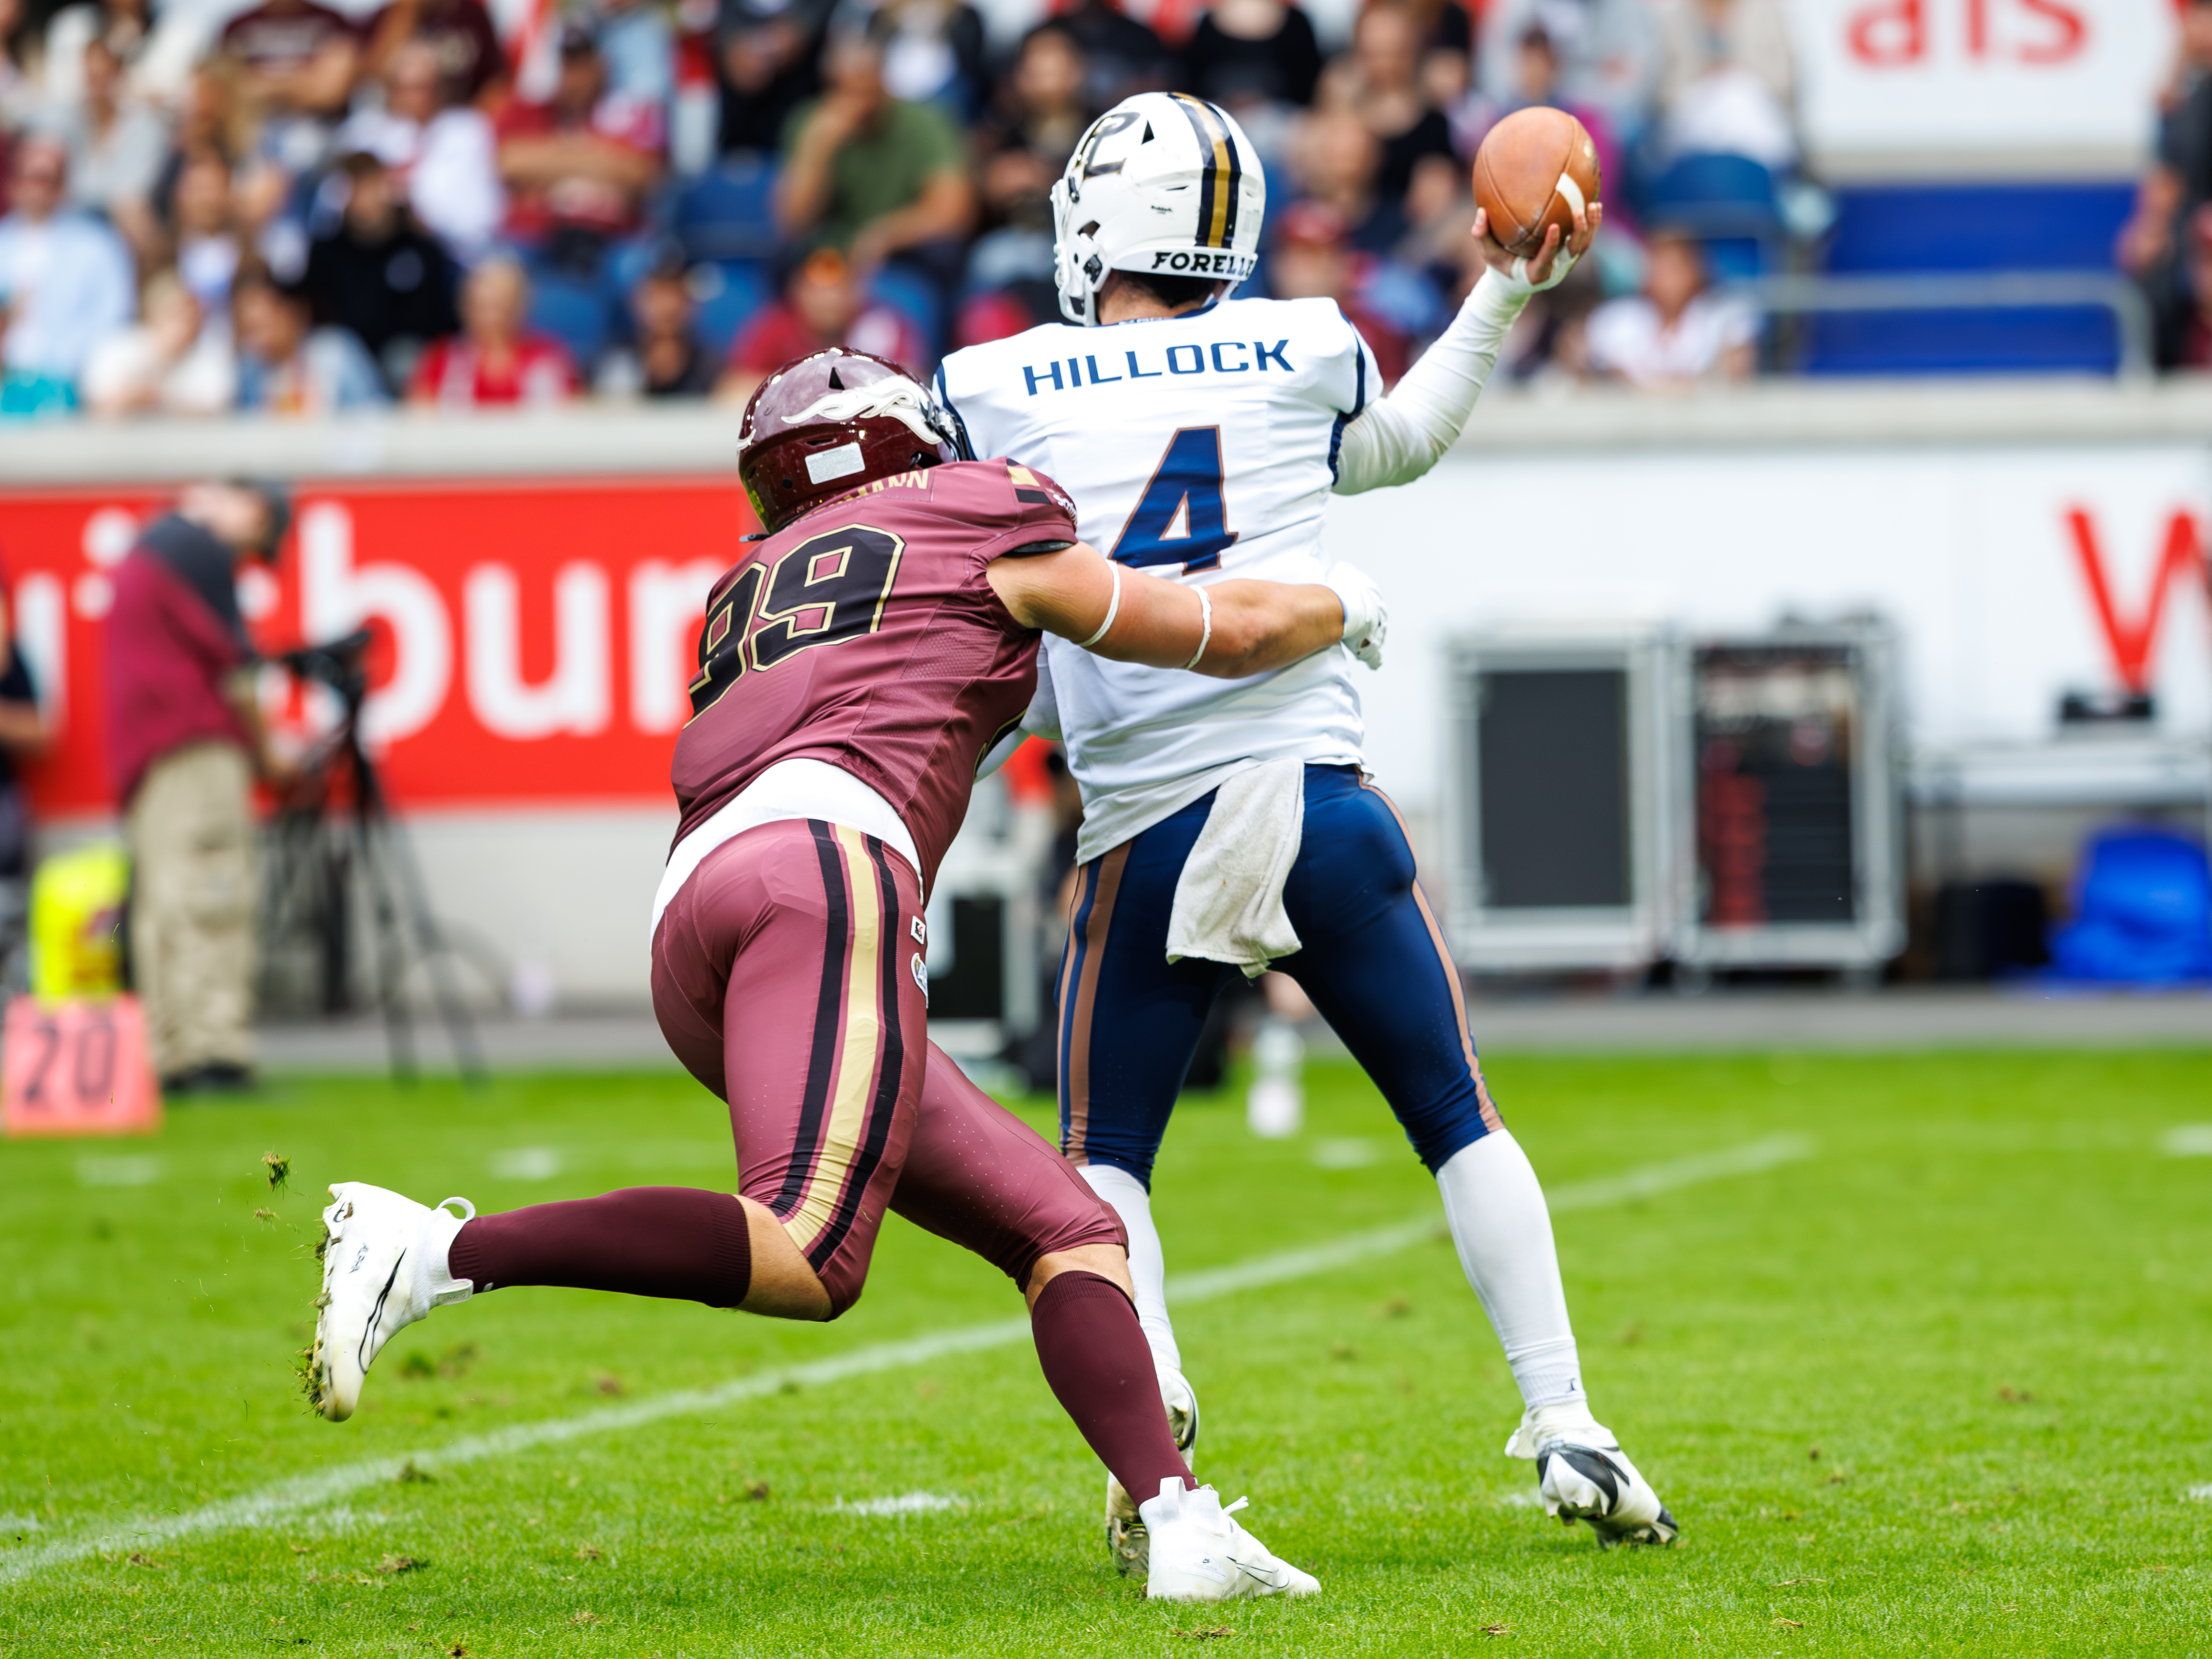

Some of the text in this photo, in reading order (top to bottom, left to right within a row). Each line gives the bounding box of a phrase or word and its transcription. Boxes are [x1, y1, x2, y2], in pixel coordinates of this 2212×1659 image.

[1021, 339, 1296, 396] HILLOCK
[1107, 424, 1239, 576] 4
[682, 523, 906, 729] 99
[24, 1018, 118, 1106] 20
